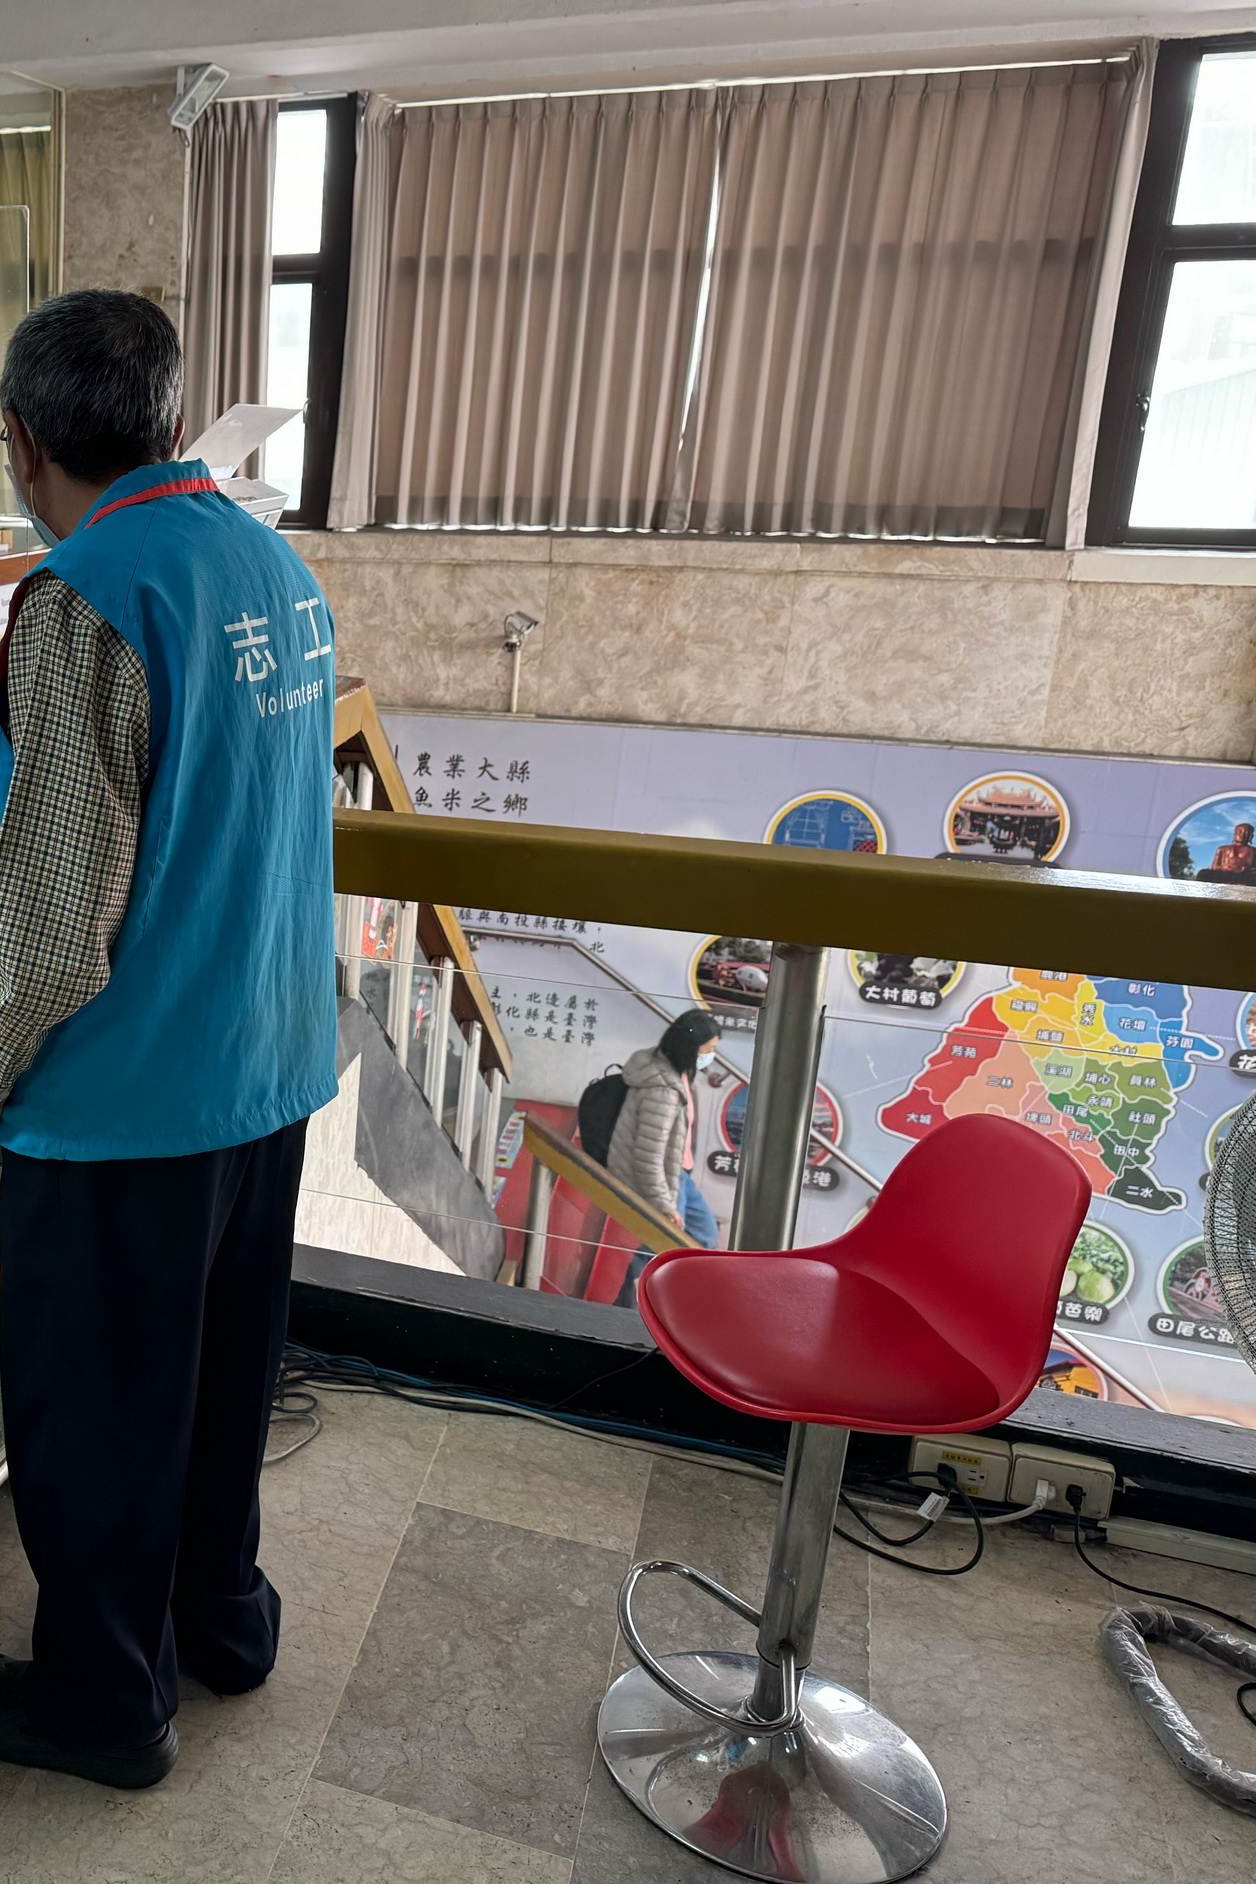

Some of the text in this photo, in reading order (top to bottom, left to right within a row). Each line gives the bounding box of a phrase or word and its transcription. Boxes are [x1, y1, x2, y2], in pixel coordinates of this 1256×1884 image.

[224, 597, 332, 682] 志工
[255, 678, 324, 718] Volunteer
[413, 751, 530, 783] 農業大縣
[413, 786, 528, 817] 魚米之鄉
[865, 985, 937, 1007] 大村葡萄
[1128, 983, 1156, 997] 彰化
[1081, 1003, 1096, 1027] 秀水
[1120, 1018, 1146, 1031] 花壇
[1166, 1035, 1194, 1049] 芬園
[951, 1045, 977, 1058] 芳苑
[1045, 1063, 1073, 1077] 溪湖
[987, 1075, 1013, 1089] 二林
[1085, 1072, 1111, 1085] 埔心
[1130, 1074, 1157, 1088] 員林
[1087, 1096, 1113, 1108] 永靖
[1025, 1111, 1052, 1126] 埤頭
[1063, 1105, 1089, 1118] 田尾
[1128, 1111, 1156, 1125] 社頭
[906, 1112, 932, 1126] 大城
[1068, 1129, 1094, 1142] 北斗
[1114, 1144, 1140, 1157] 田中
[1126, 1185, 1154, 1198] 二水
